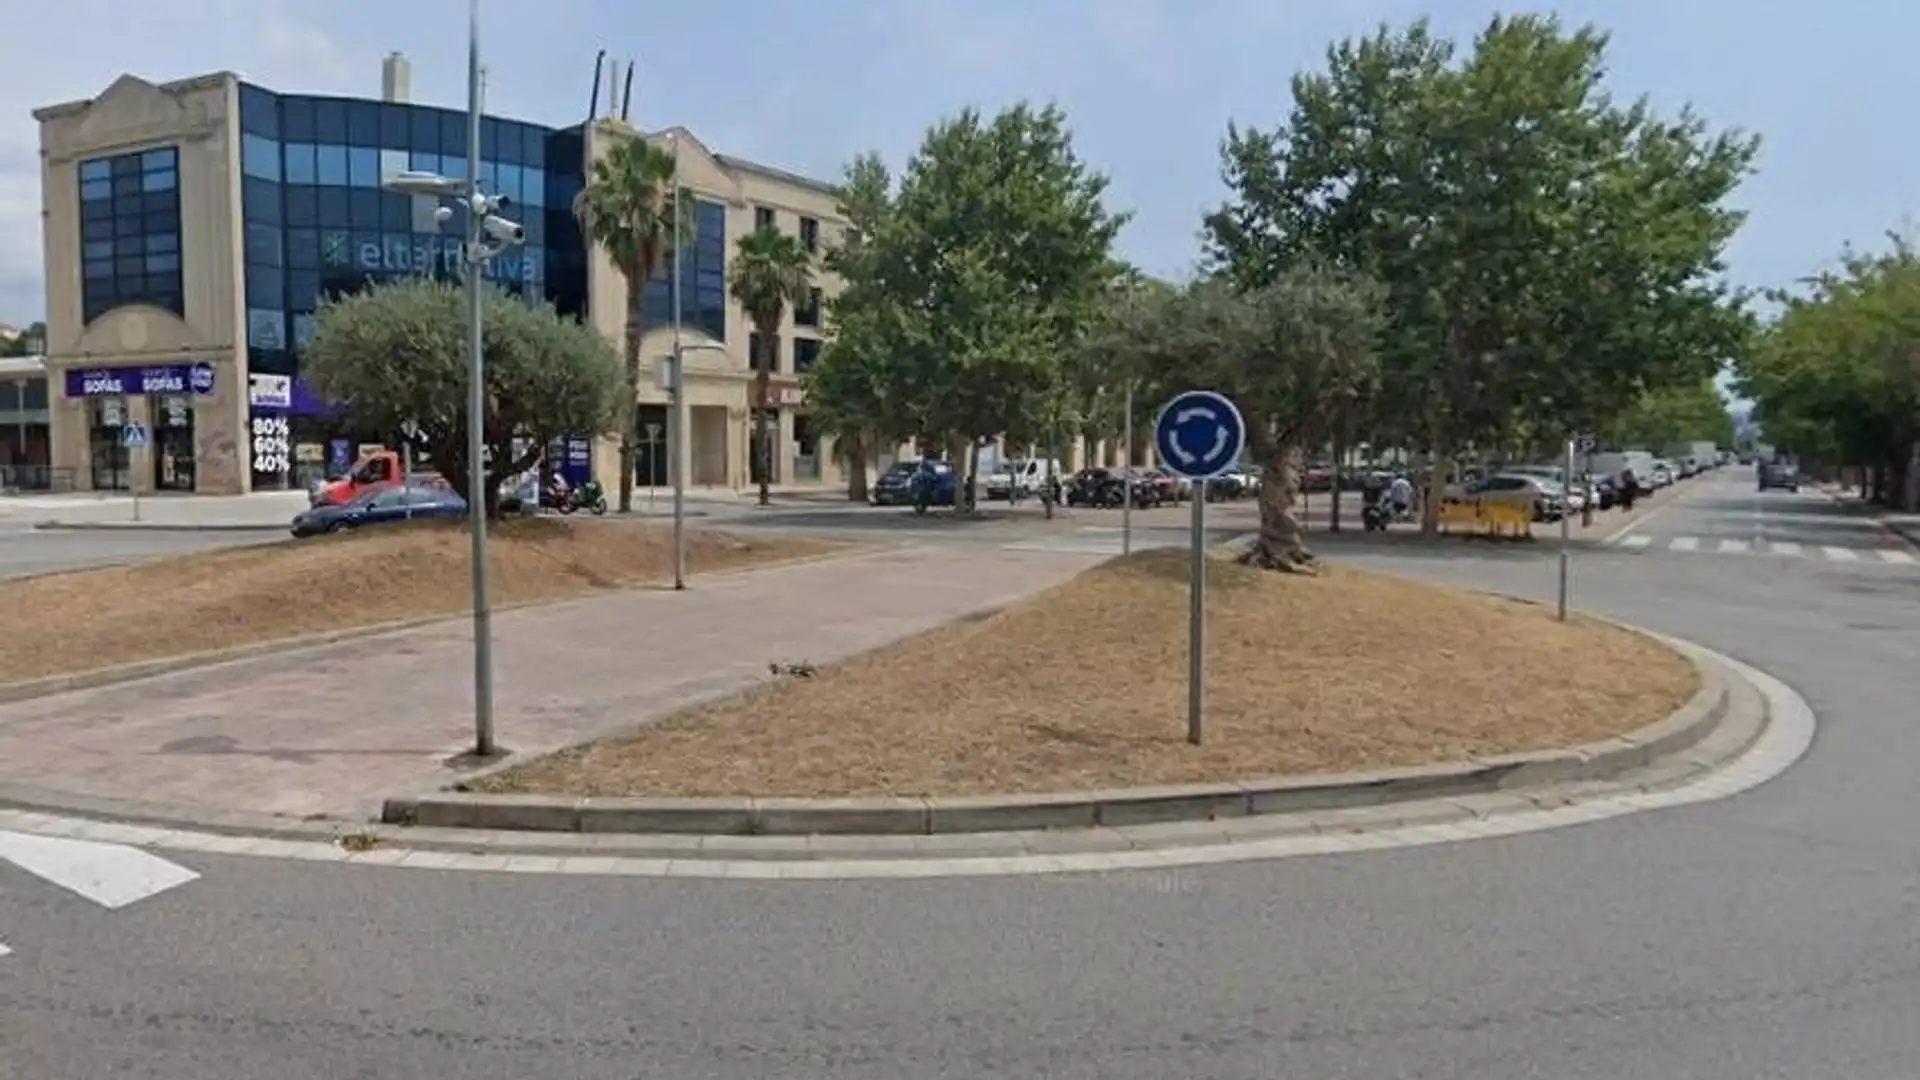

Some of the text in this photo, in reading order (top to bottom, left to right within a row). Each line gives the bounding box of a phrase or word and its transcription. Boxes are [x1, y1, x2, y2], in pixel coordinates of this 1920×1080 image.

[253, 417, 289, 435] 80%
[253, 436, 289, 453] 60%
[253, 455, 291, 472] 40%
